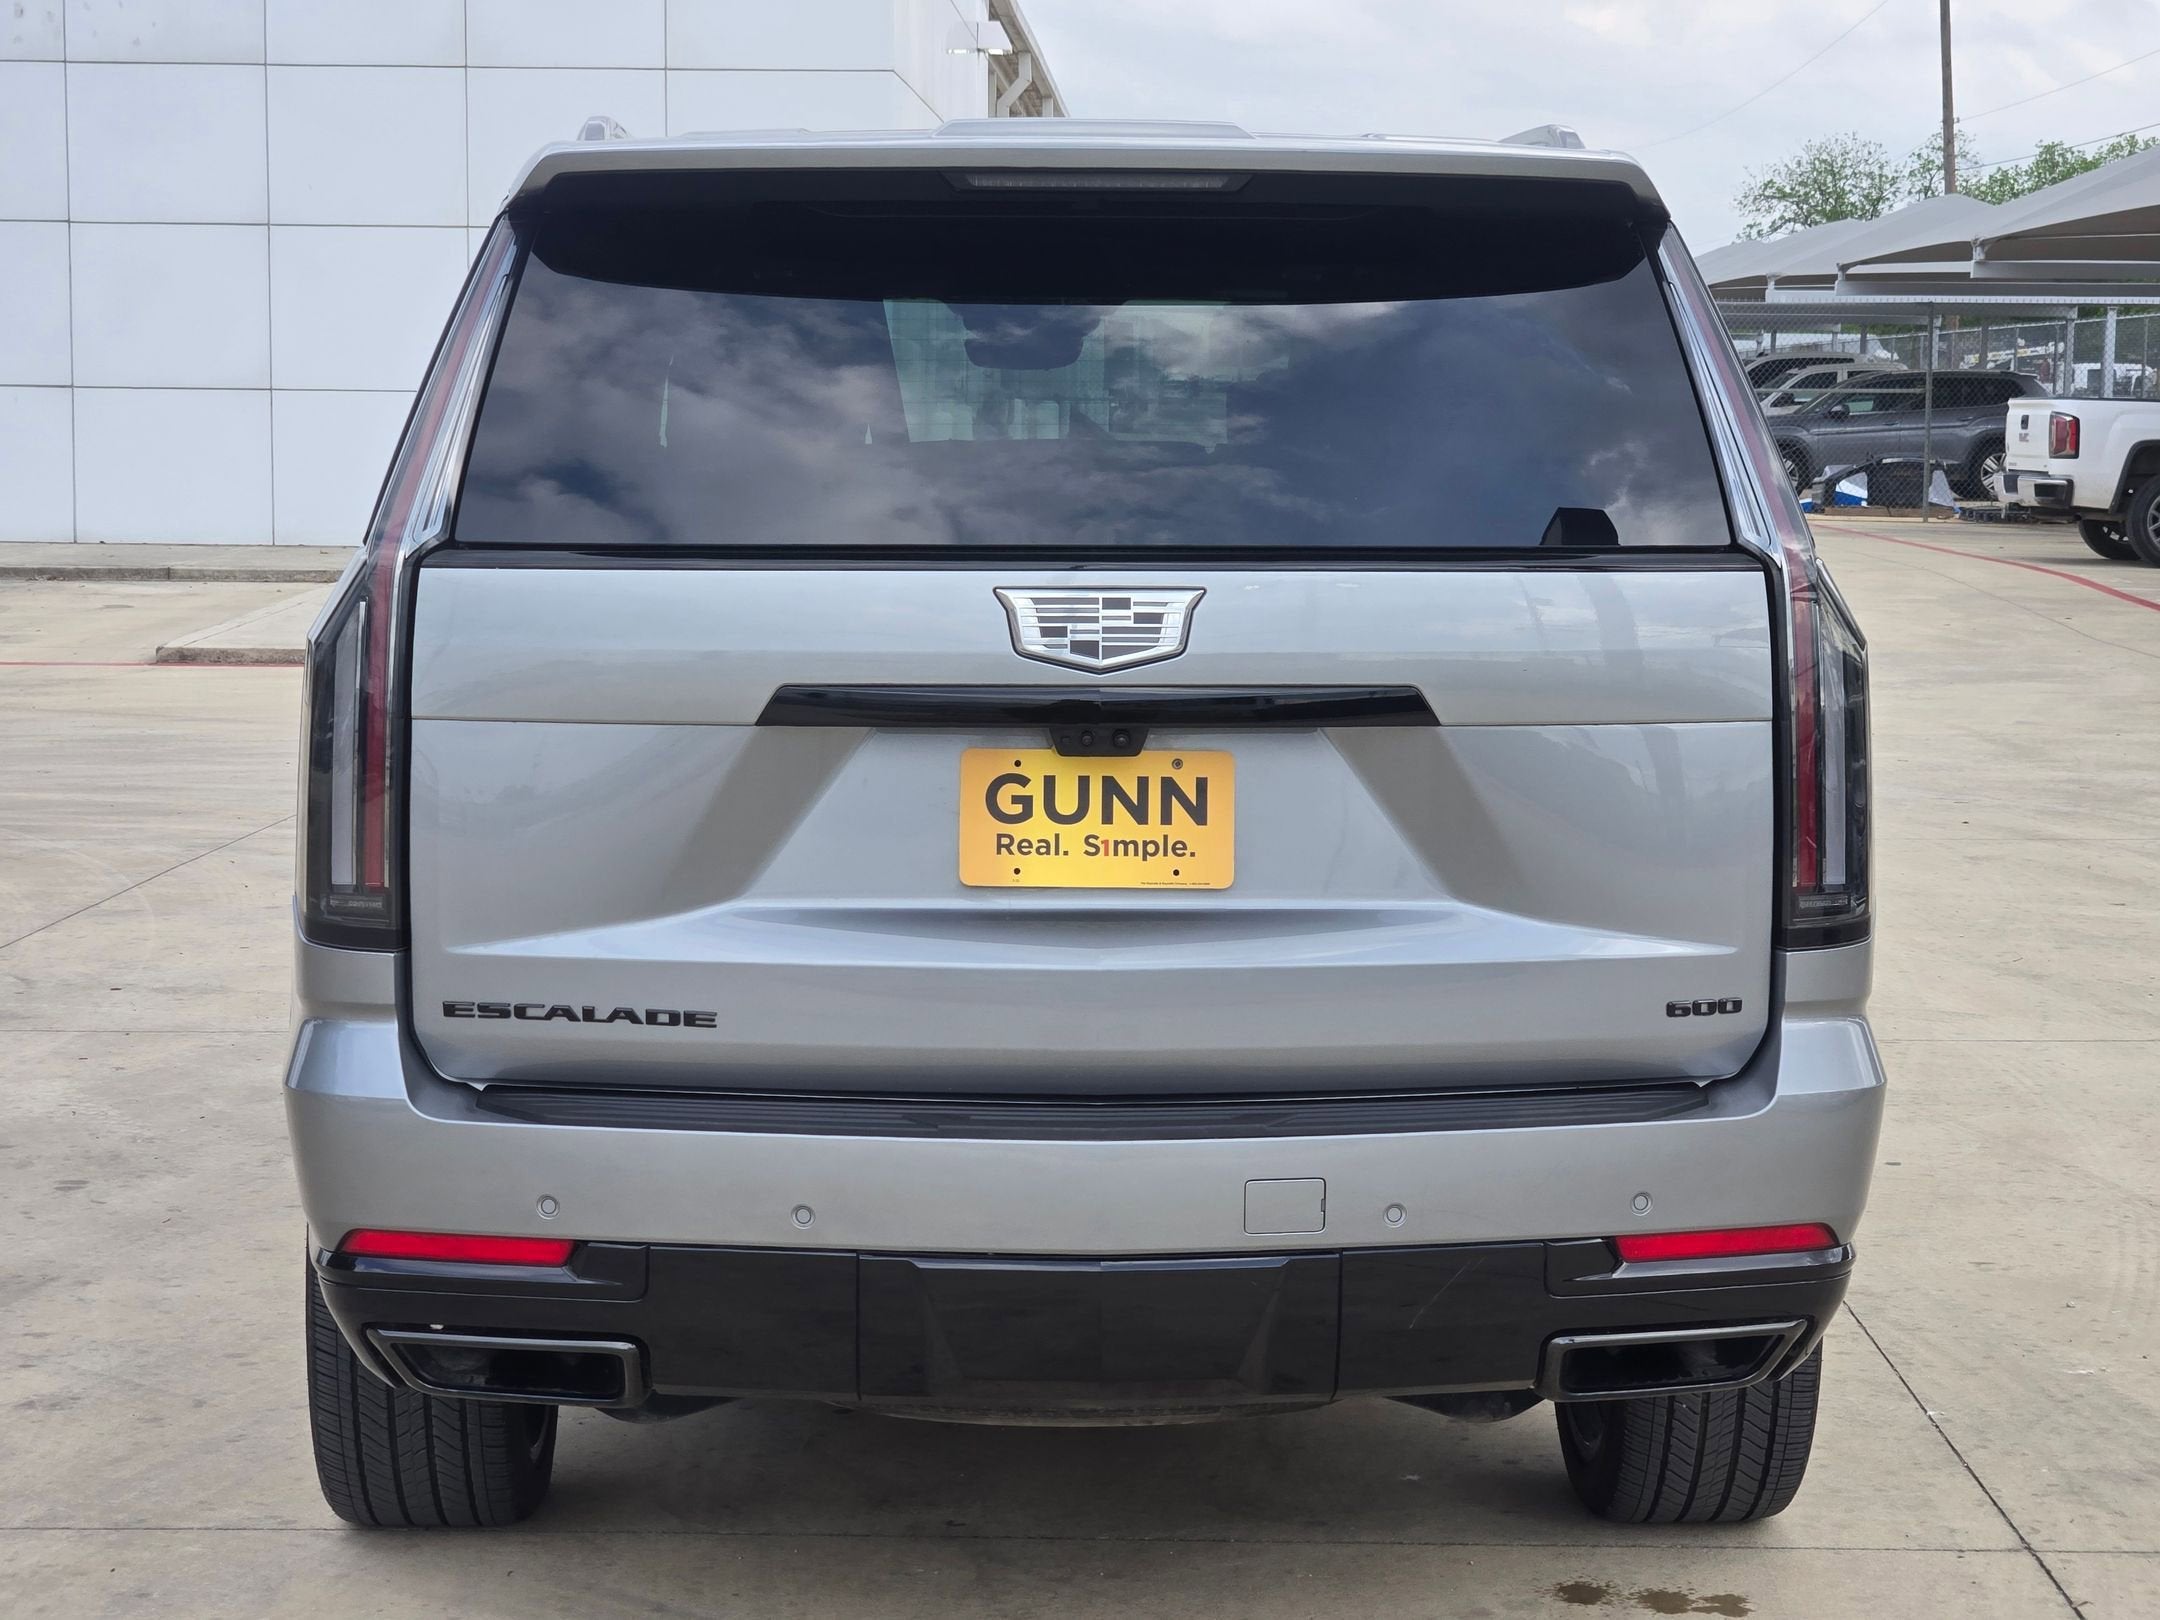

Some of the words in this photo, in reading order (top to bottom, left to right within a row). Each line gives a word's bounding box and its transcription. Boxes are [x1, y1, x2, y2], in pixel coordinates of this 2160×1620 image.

[985, 773, 1208, 826] GUNN
[996, 833, 1069, 856] Real.
[442, 1001, 717, 1028] ESCALADE
[1666, 997, 1743, 1017] 600
